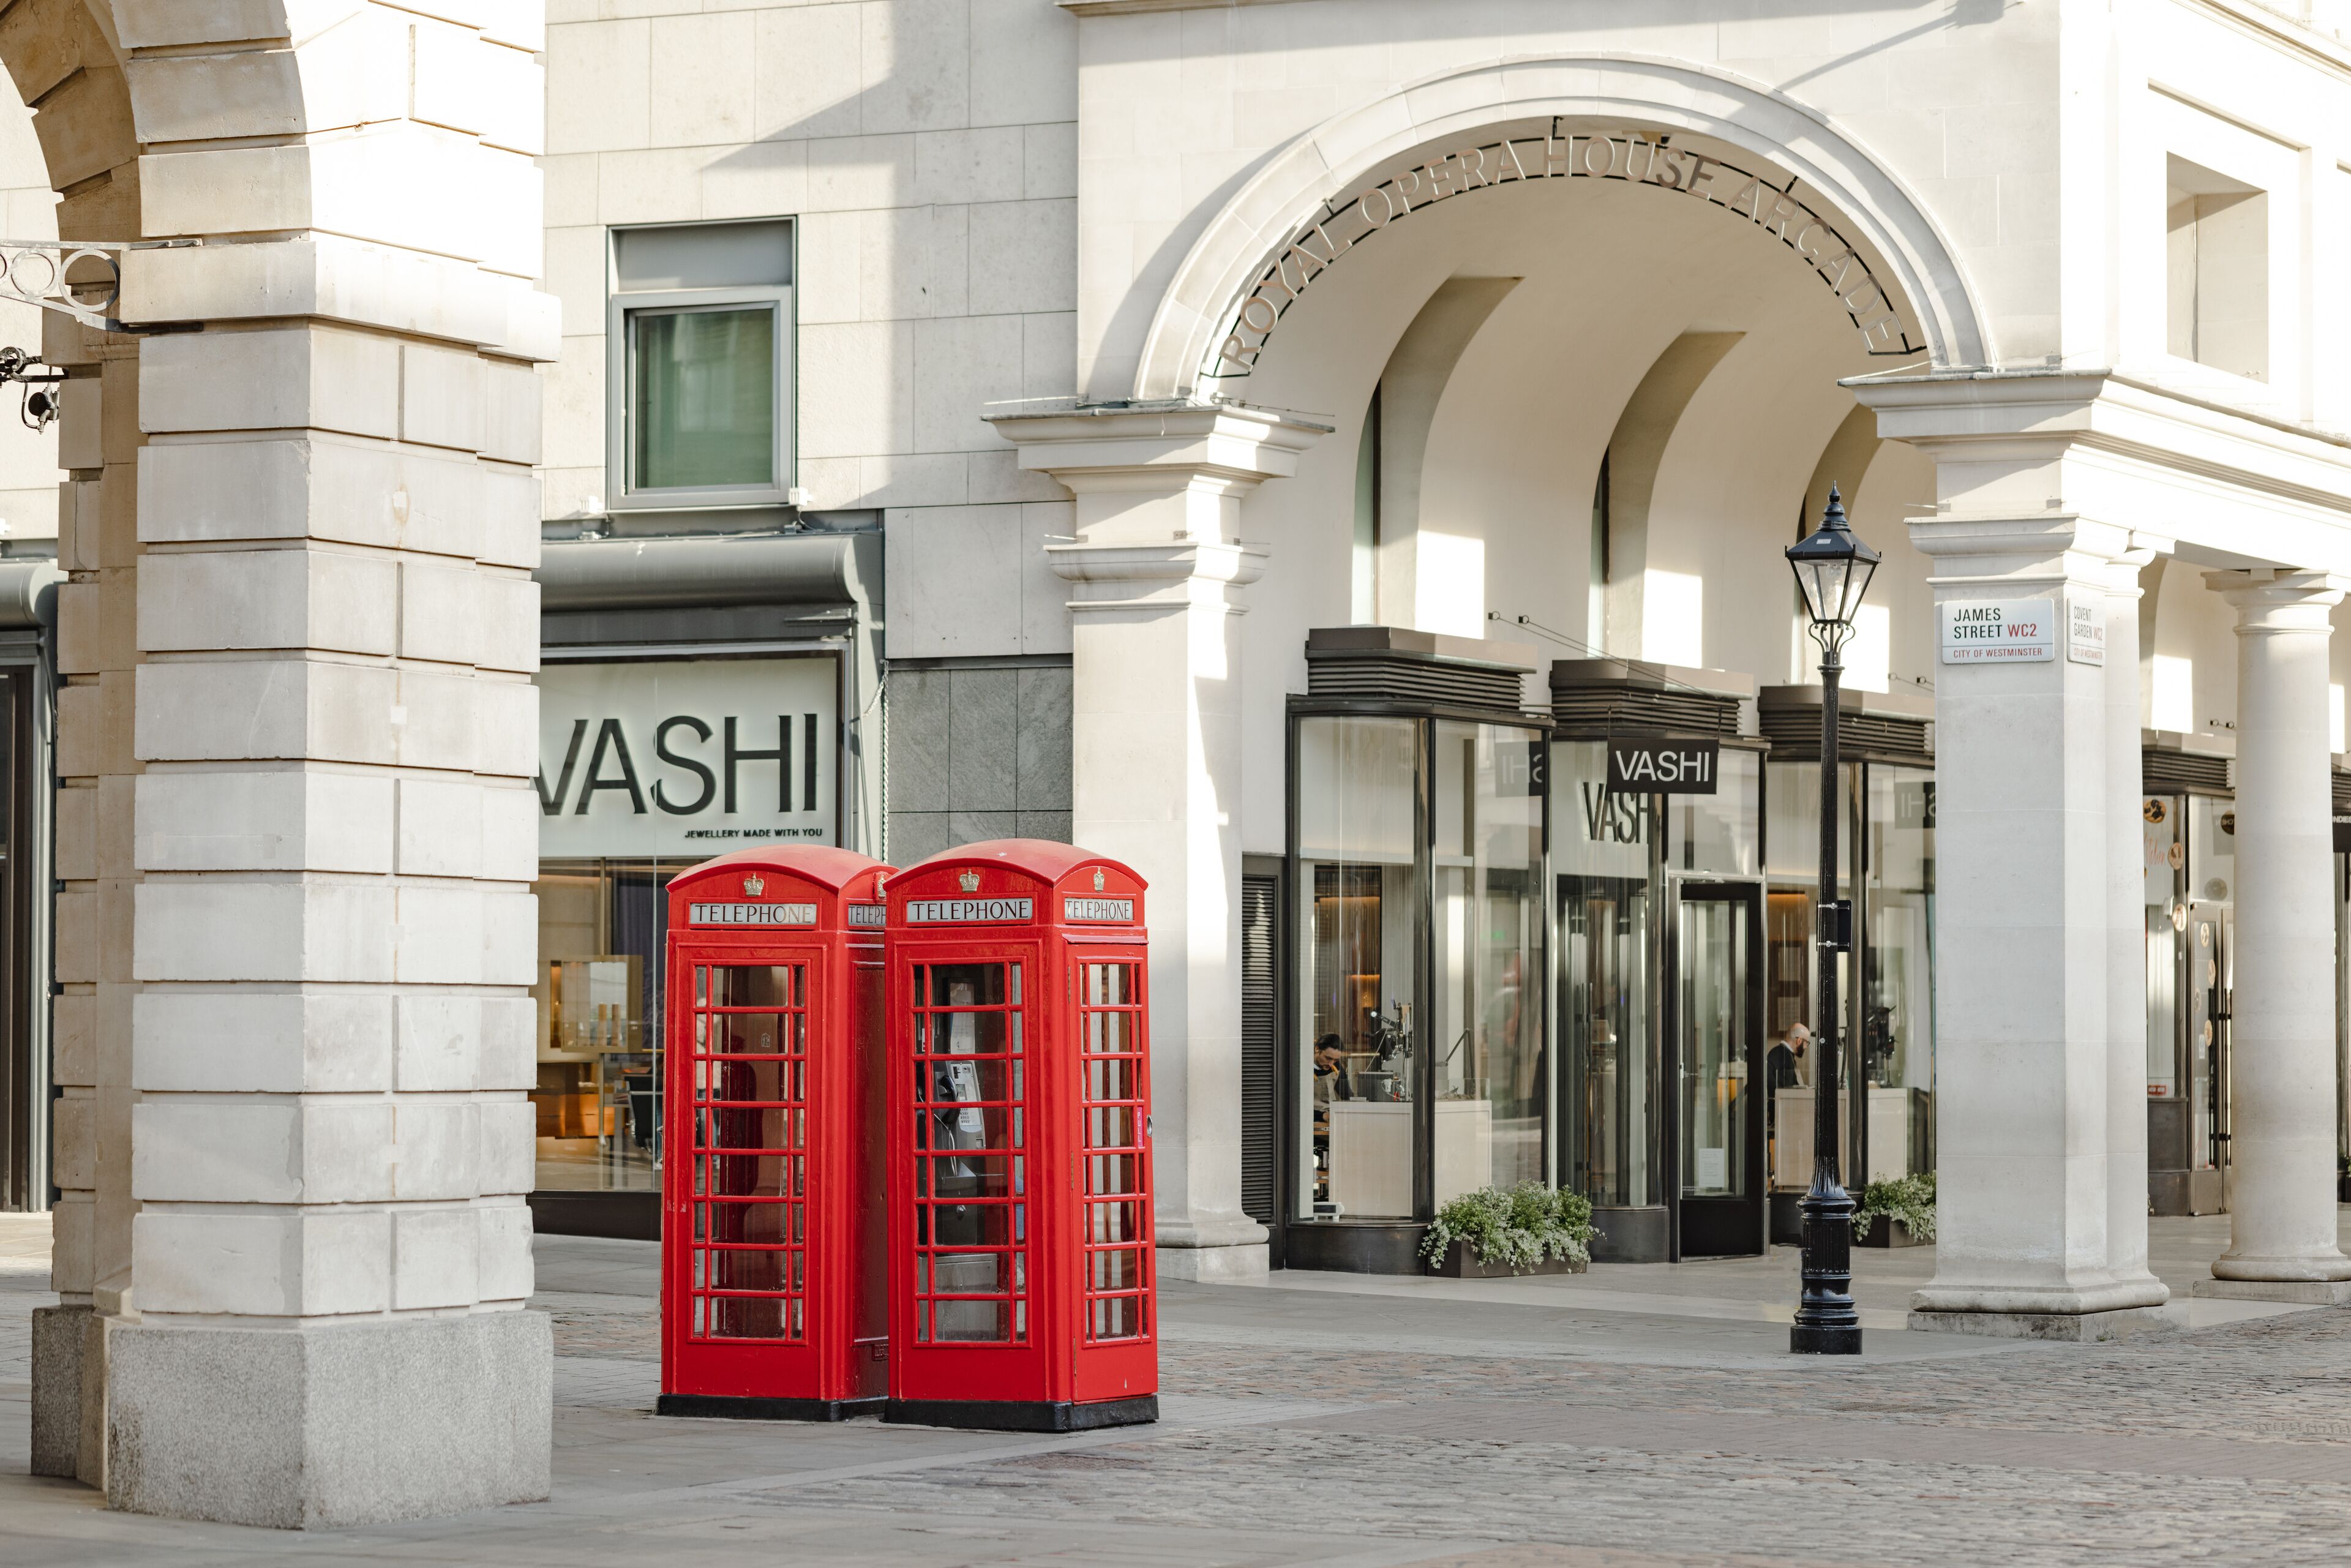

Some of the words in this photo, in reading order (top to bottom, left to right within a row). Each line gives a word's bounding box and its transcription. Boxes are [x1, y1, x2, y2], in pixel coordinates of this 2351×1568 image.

[1219, 222, 1352, 373] ROYAL
[1357, 140, 1526, 229] OPERA
[1543, 135, 1721, 201] HOUSE
[1724, 176, 1904, 353] ARCADE
[1954, 607, 2001, 622] JAMES
[2074, 606, 2091, 622] COVENT
[1954, 625, 2003, 639] STREET
[2007, 623, 2038, 637] WC2
[2074, 623, 2092, 639] GARDEN
[2093, 626, 2103, 642] WC2
[1953, 649, 1971, 659] CITY
[1974, 649, 1984, 658] OF
[1985, 647, 2042, 657] WESTMINSTER
[2084, 650, 2103, 660] WESTMINSTER
[533, 713, 818, 816] VASHI
[1615, 750, 1710, 782] VASHI
[684, 829, 741, 839] JEWELLERY
[743, 828, 771, 838] MADE
[774, 828, 800, 838] WITH
[802, 828, 823, 837] YOU
[694, 905, 813, 923] TELEPHONE
[912, 900, 1029, 920] TELEPHONE
[1065, 900, 1130, 920] TELEPHONE
